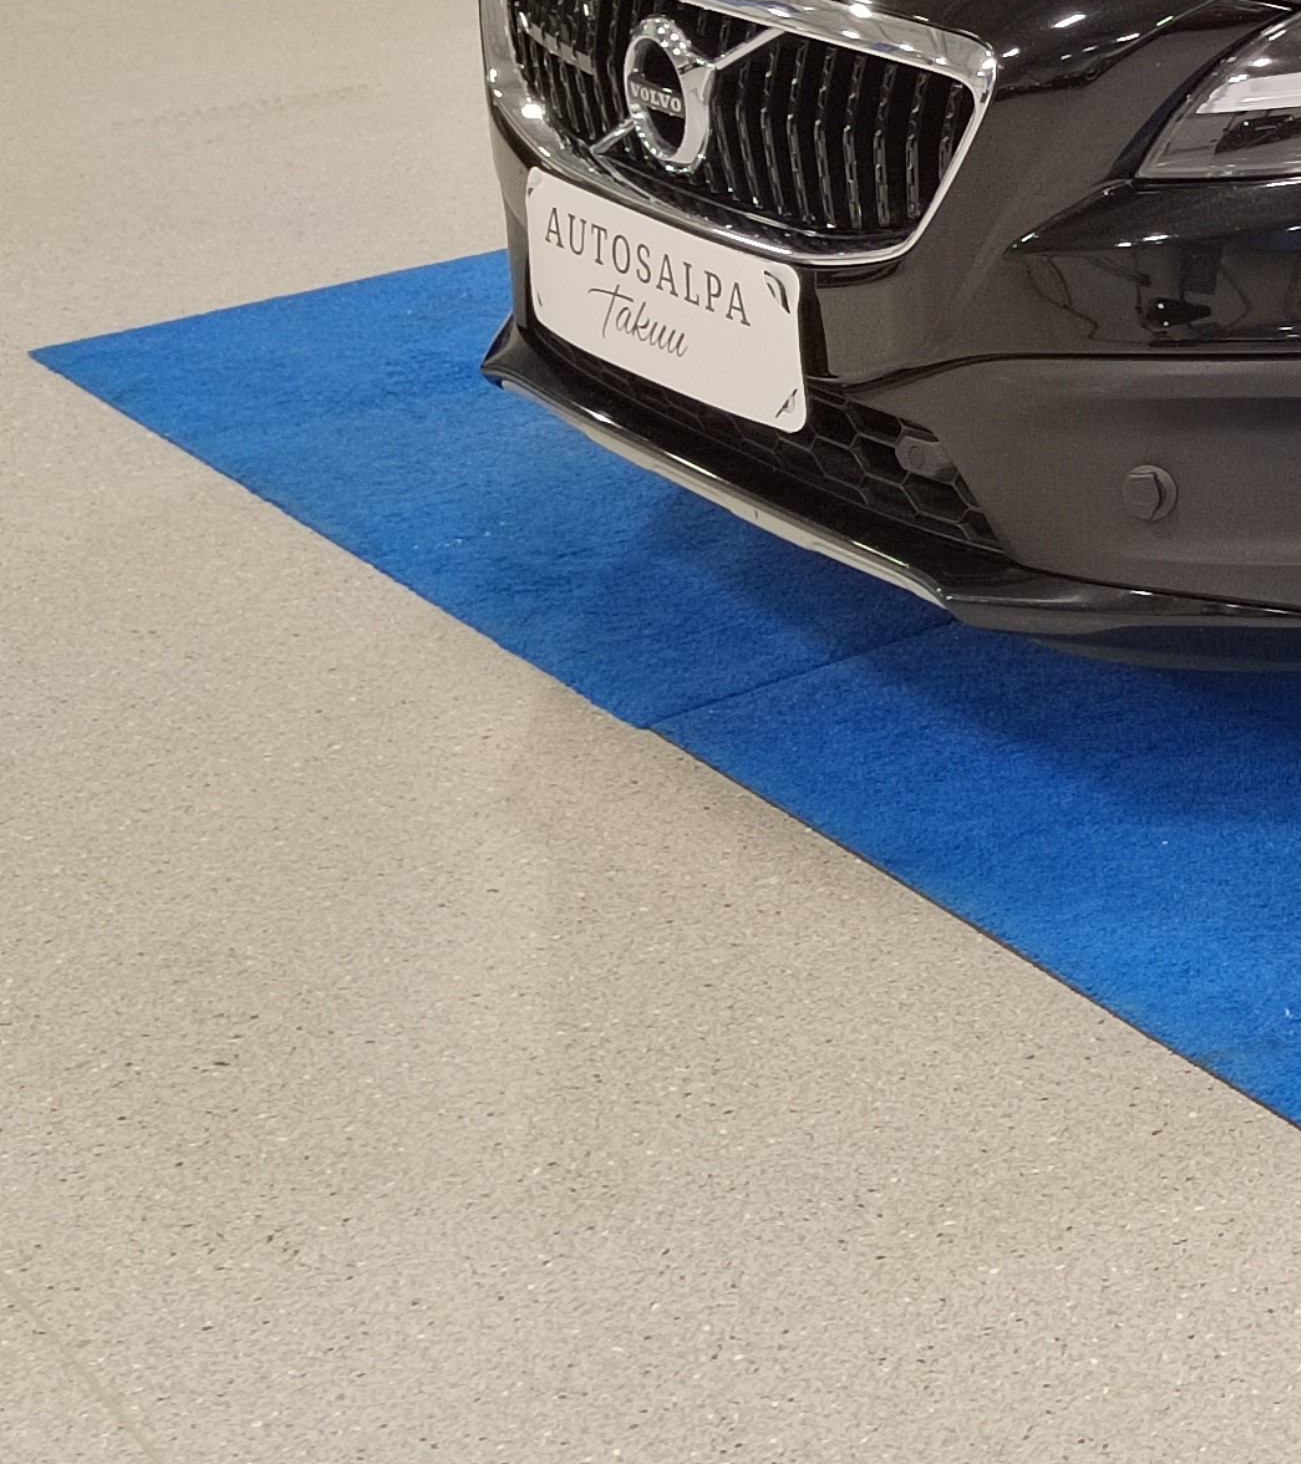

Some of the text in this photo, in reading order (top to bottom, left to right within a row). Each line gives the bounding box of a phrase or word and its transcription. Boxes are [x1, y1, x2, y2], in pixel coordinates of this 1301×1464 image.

[629, 80, 682, 113] VOLVO
[543, 205, 752, 328] AUTOSALPA
[587, 283, 689, 358] Takuu
